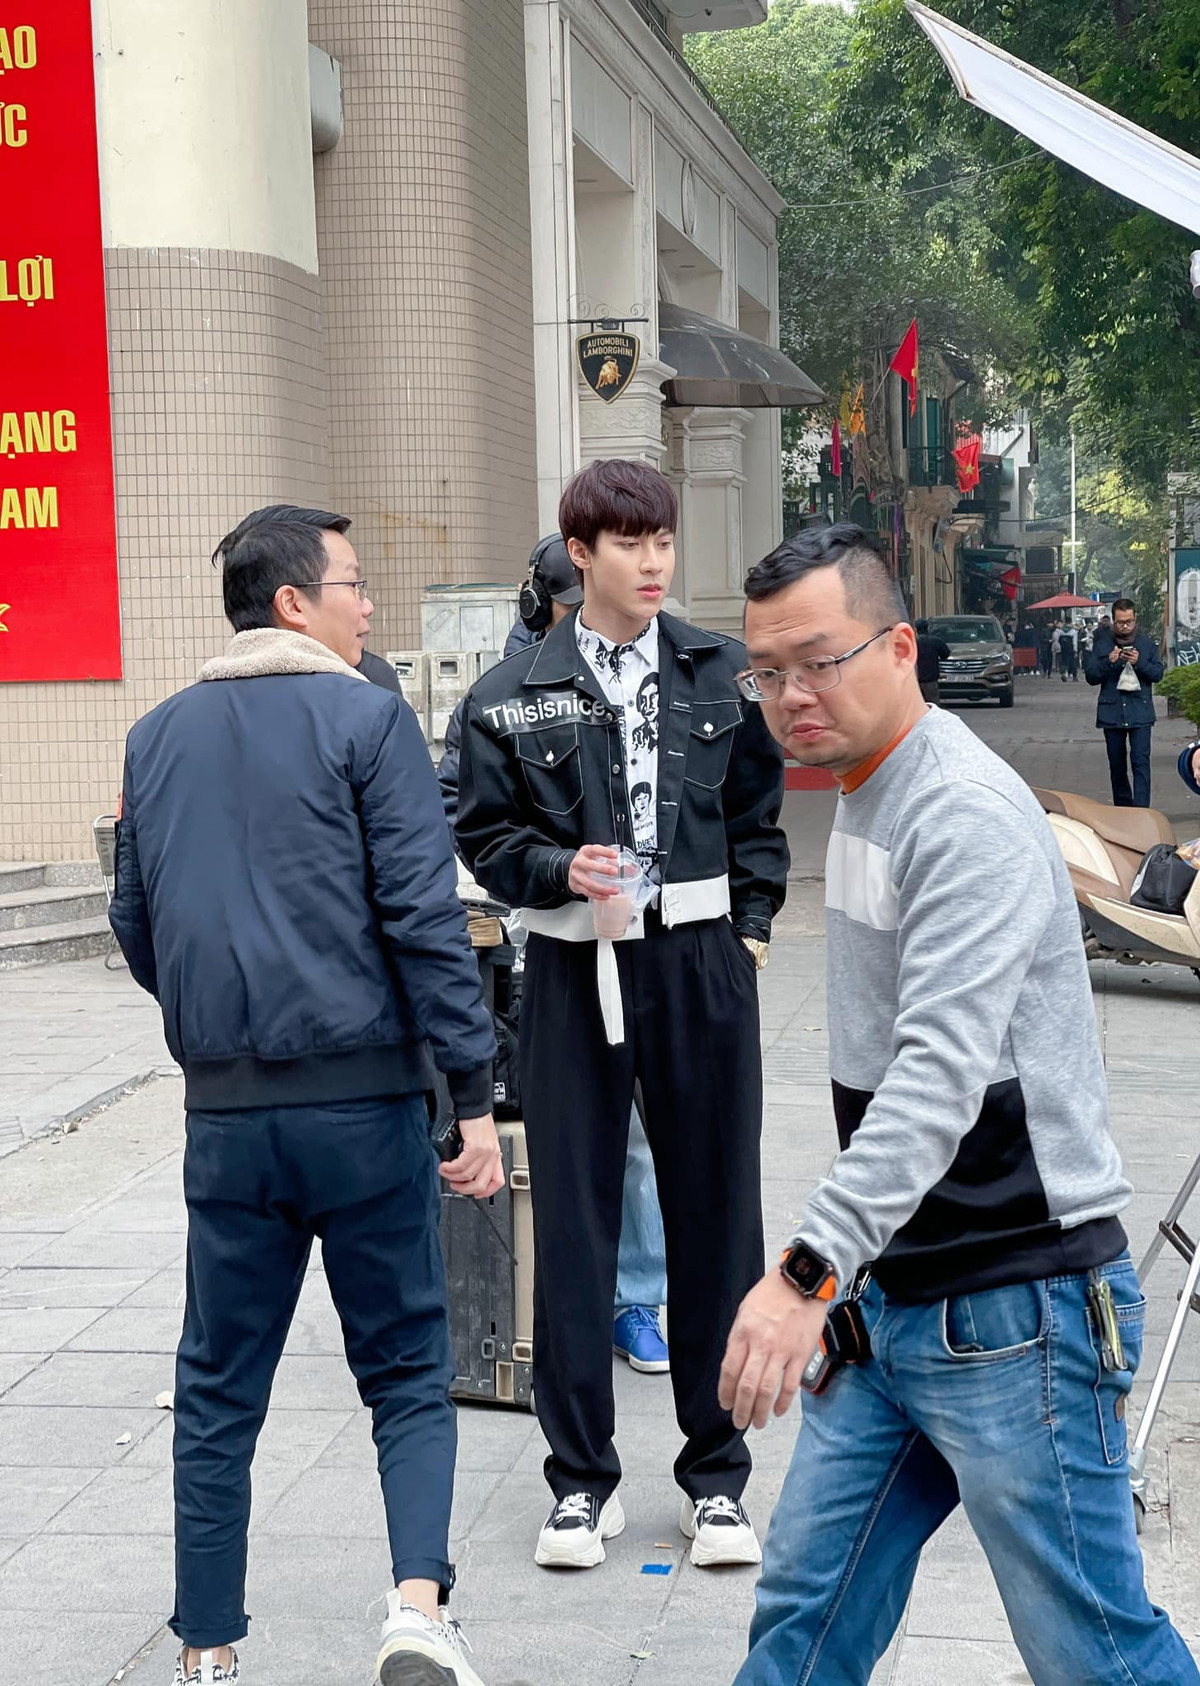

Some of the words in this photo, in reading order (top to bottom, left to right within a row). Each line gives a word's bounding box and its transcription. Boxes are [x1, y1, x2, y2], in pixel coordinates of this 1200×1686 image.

[0, 254, 54, 307] LỢI
[583, 346, 633, 358] LAMBORGHINI
[586, 337, 629, 348] AUTOMOBILI
[0, 409, 77, 459] ẠNG
[0, 486, 59, 529] AM
[484, 693, 606, 729] Thisisnice
